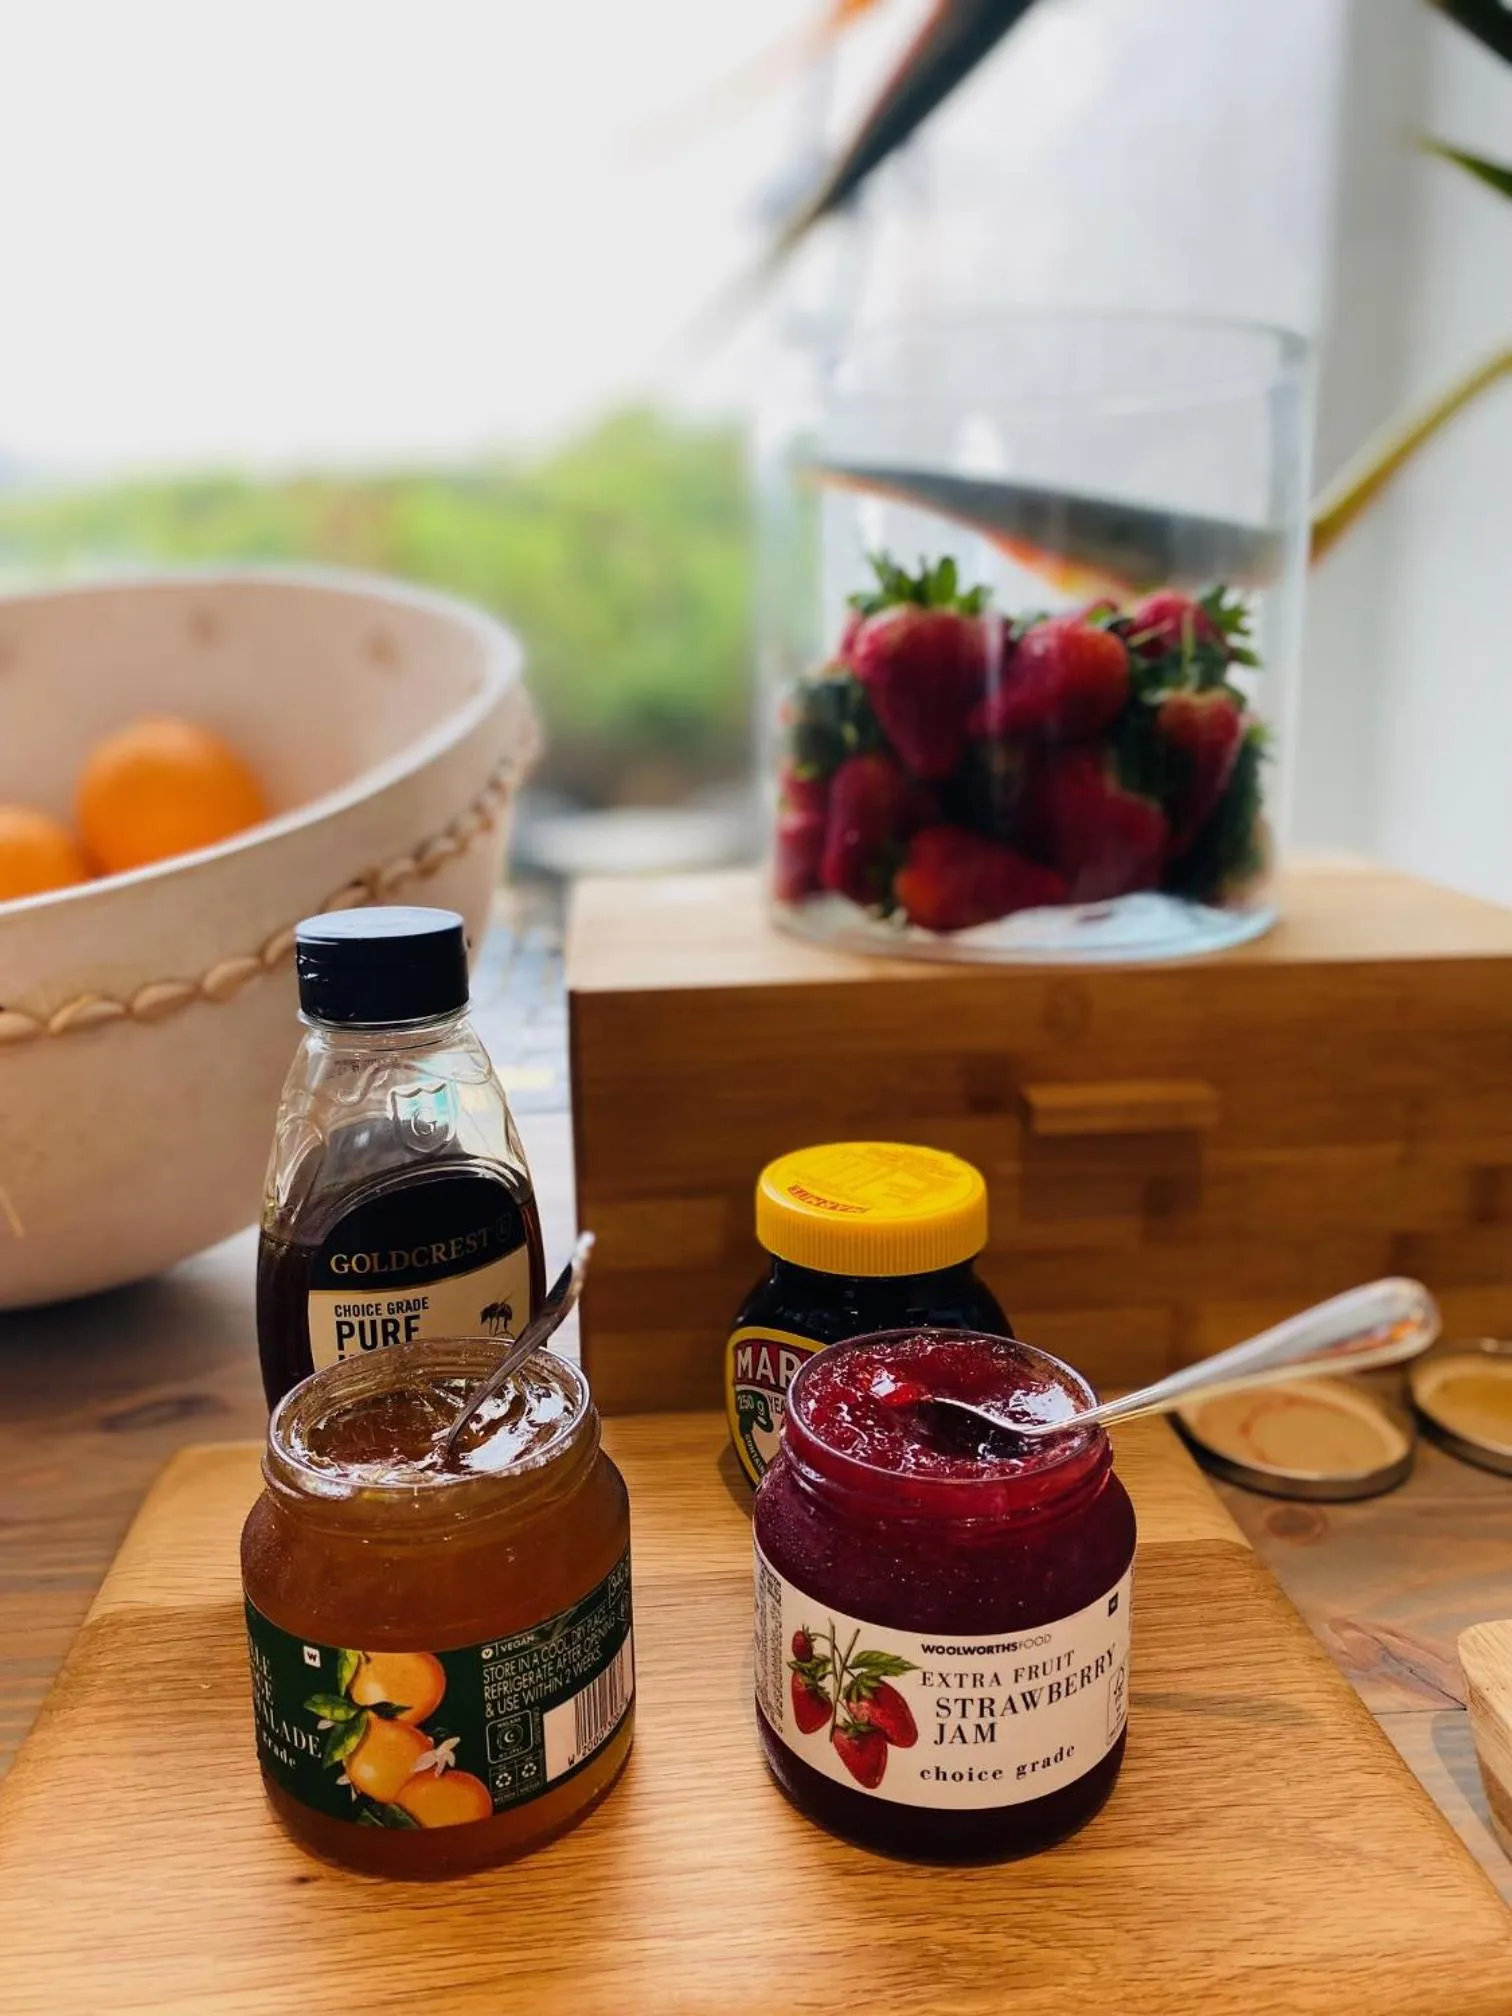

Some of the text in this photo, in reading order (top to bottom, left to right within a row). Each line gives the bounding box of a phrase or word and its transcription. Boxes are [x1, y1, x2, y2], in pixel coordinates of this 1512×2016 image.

[330, 1228, 491, 1274] GOLDCREST
[334, 1297, 429, 1318] CHOICE GRADE
[737, 1346, 801, 1389] MAR
[768, 1395, 786, 1413] YEA
[500, 1634, 535, 1652] VEGAN
[483, 1660, 516, 1685] STORE
[518, 1655, 531, 1672] IN
[533, 1654, 540, 1666] A
[484, 1660, 554, 1700] REFRIGERATE
[556, 1643, 583, 1668] AFTER
[921, 1650, 1075, 1689] EXTRA FRUIT
[936, 1642, 1116, 1720] STRAWBERRY
[485, 1703, 495, 1718] &
[497, 1694, 520, 1714] USE
[522, 1676, 563, 1705] WITHIN
[934, 1722, 998, 1745] JAM
[920, 1745, 1075, 1783] choice grade
